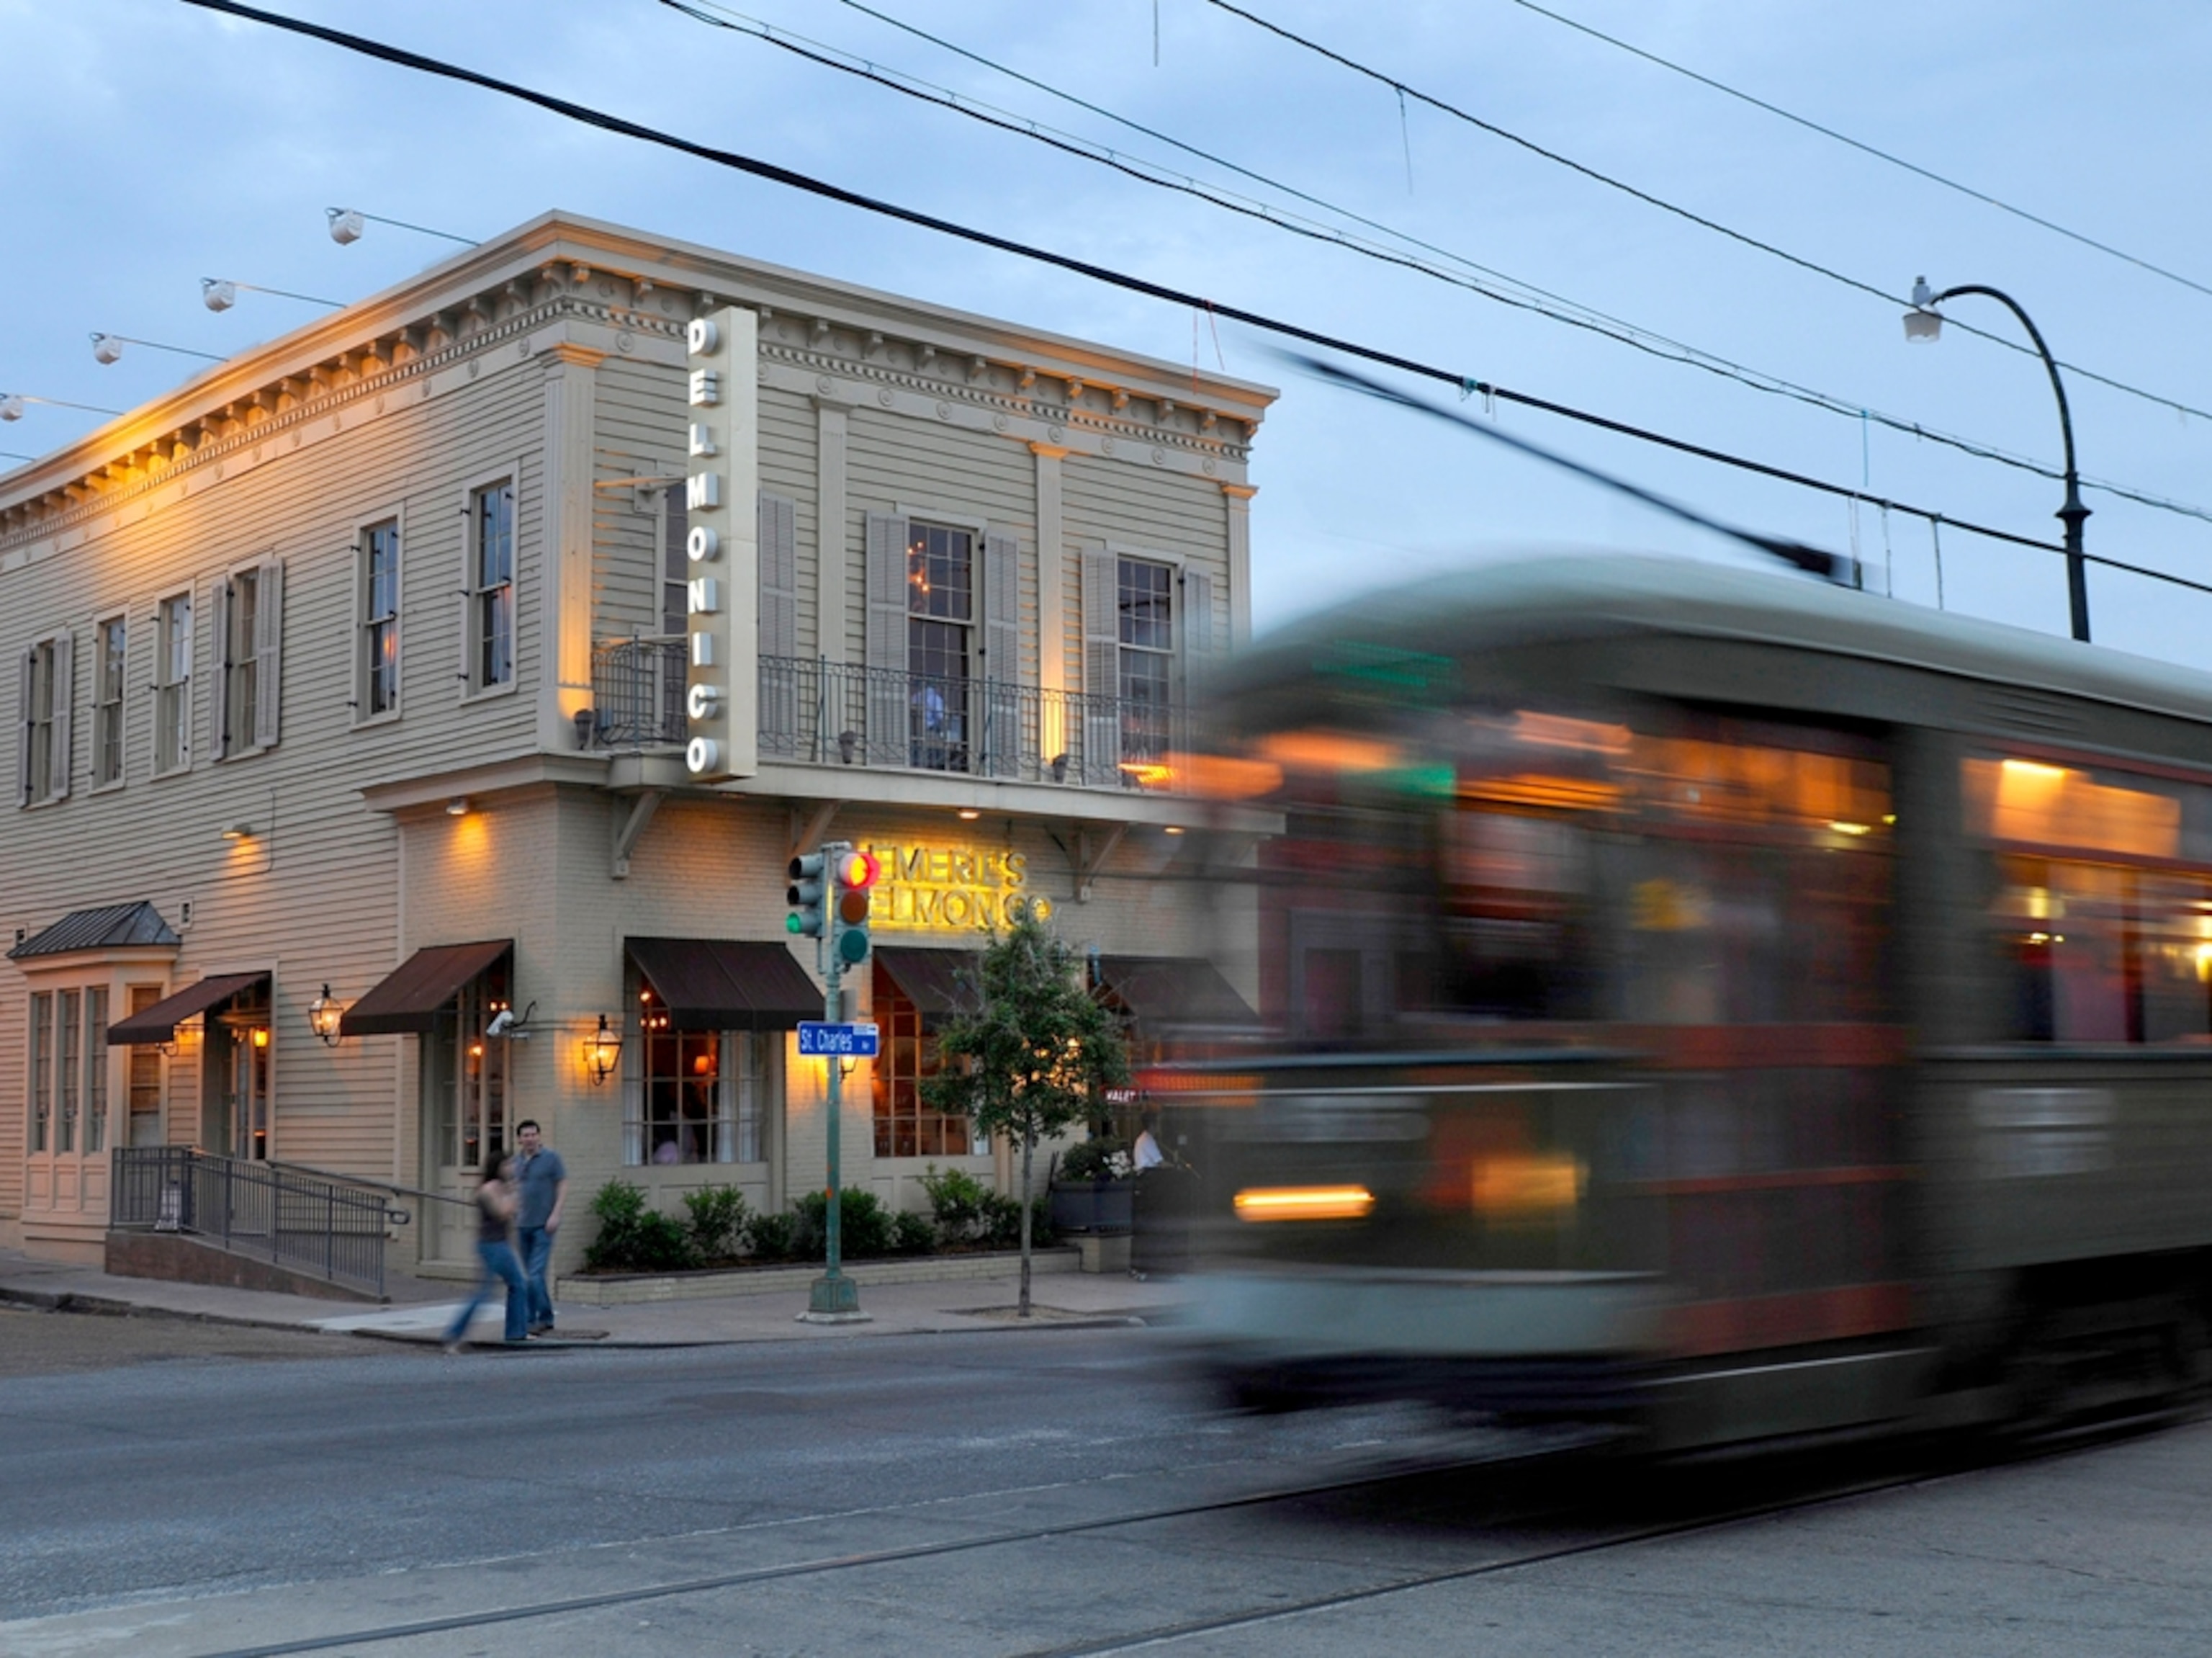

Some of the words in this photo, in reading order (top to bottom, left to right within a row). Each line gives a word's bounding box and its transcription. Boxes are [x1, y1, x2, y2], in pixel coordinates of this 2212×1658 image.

[687, 317, 716, 774] DELMONICO
[869, 843, 1026, 887] EMERIL'S
[868, 886, 1052, 926] ELMONICO
[801, 1028, 814, 1052] St.
[817, 1028, 853, 1052] Charles
[1105, 1089, 1136, 1103] VALET
